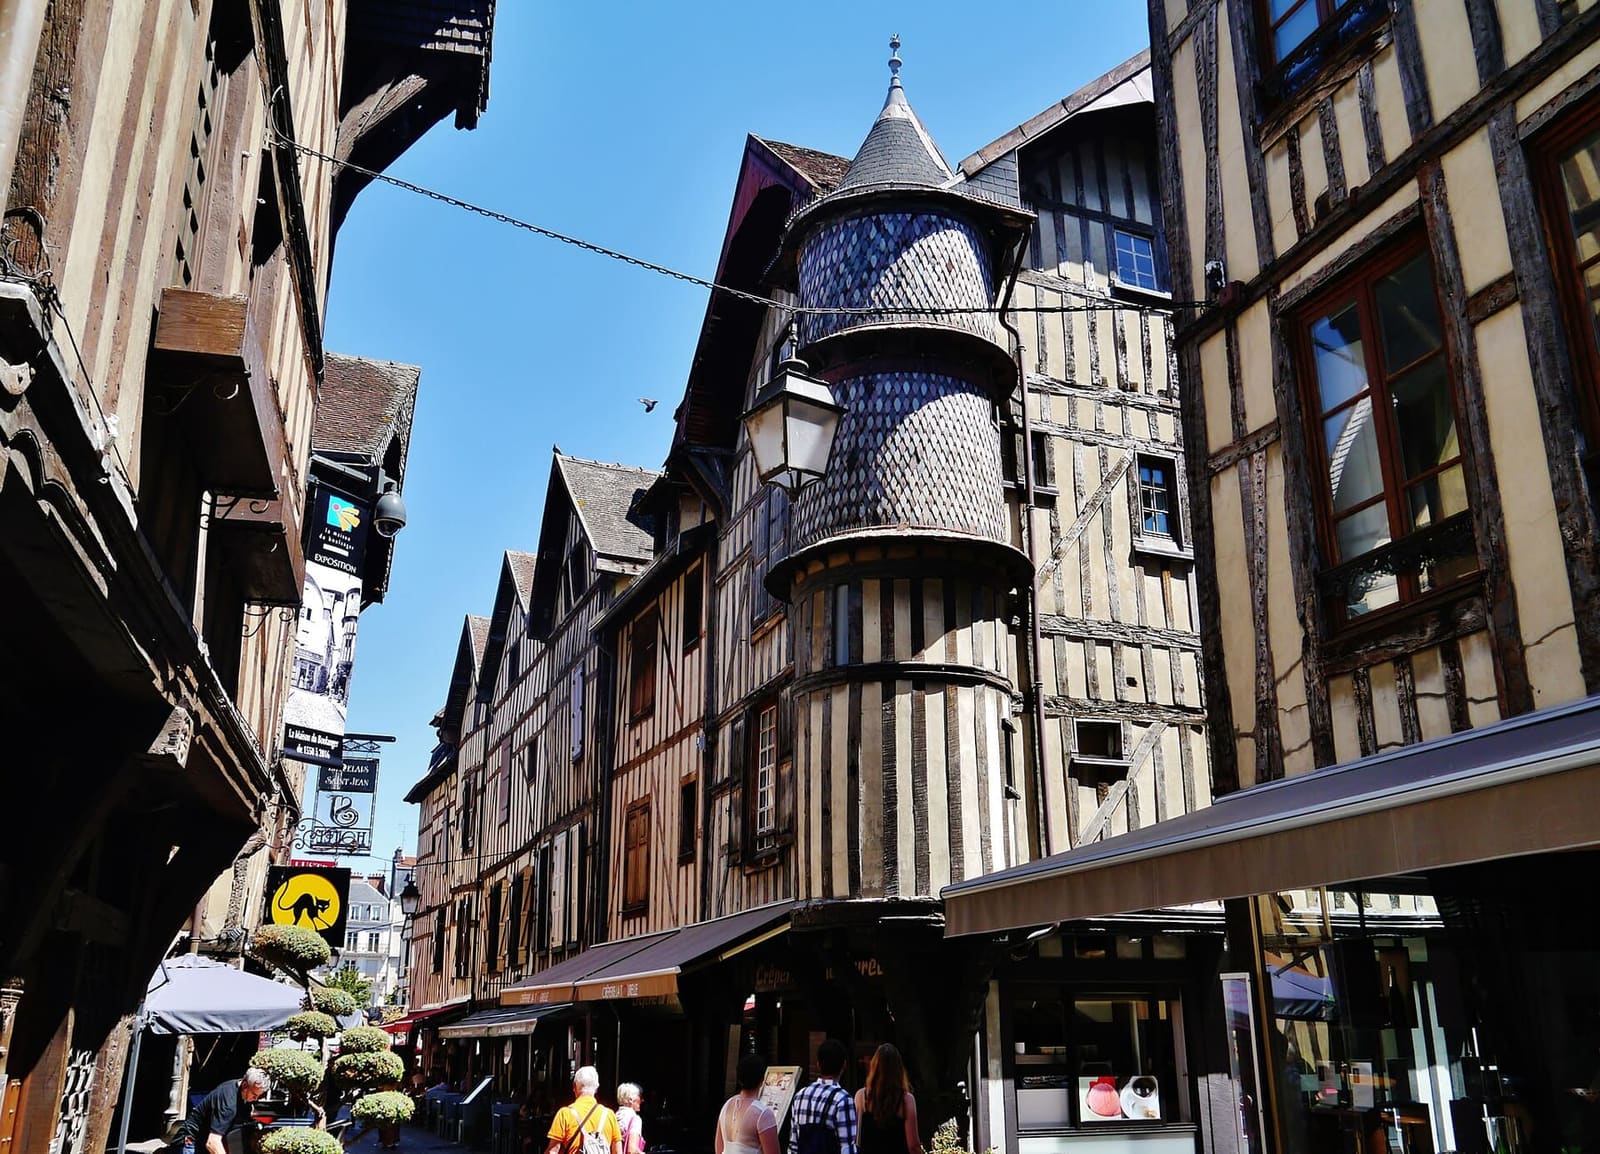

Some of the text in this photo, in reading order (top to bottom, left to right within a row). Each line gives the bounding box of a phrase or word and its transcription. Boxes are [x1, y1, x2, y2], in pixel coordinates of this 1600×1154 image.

[314, 553, 357, 573] EXPOSITION
[288, 728, 294, 738] La
[295, 730, 311, 742] Maison
